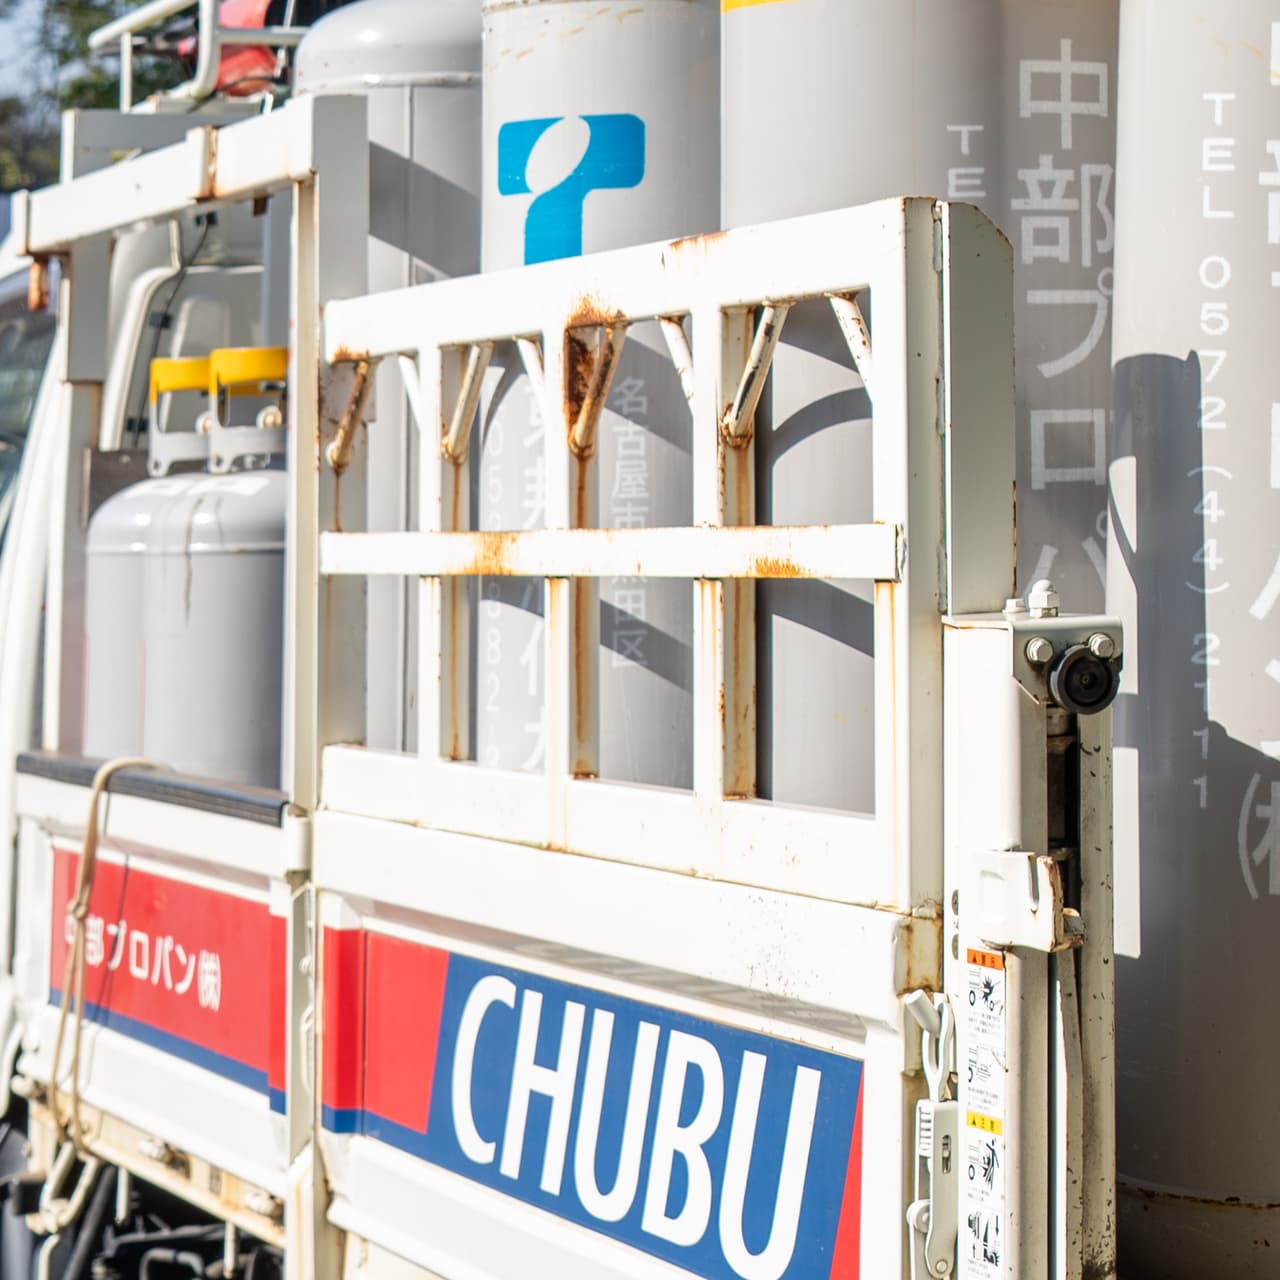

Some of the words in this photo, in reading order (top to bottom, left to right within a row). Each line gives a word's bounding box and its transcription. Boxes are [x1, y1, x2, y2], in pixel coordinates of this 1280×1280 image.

[1201, 91, 1237, 219] TEL
[610, 375, 650, 669] 名古屋市田区
[451, 975, 823, 1280] CHUBU
